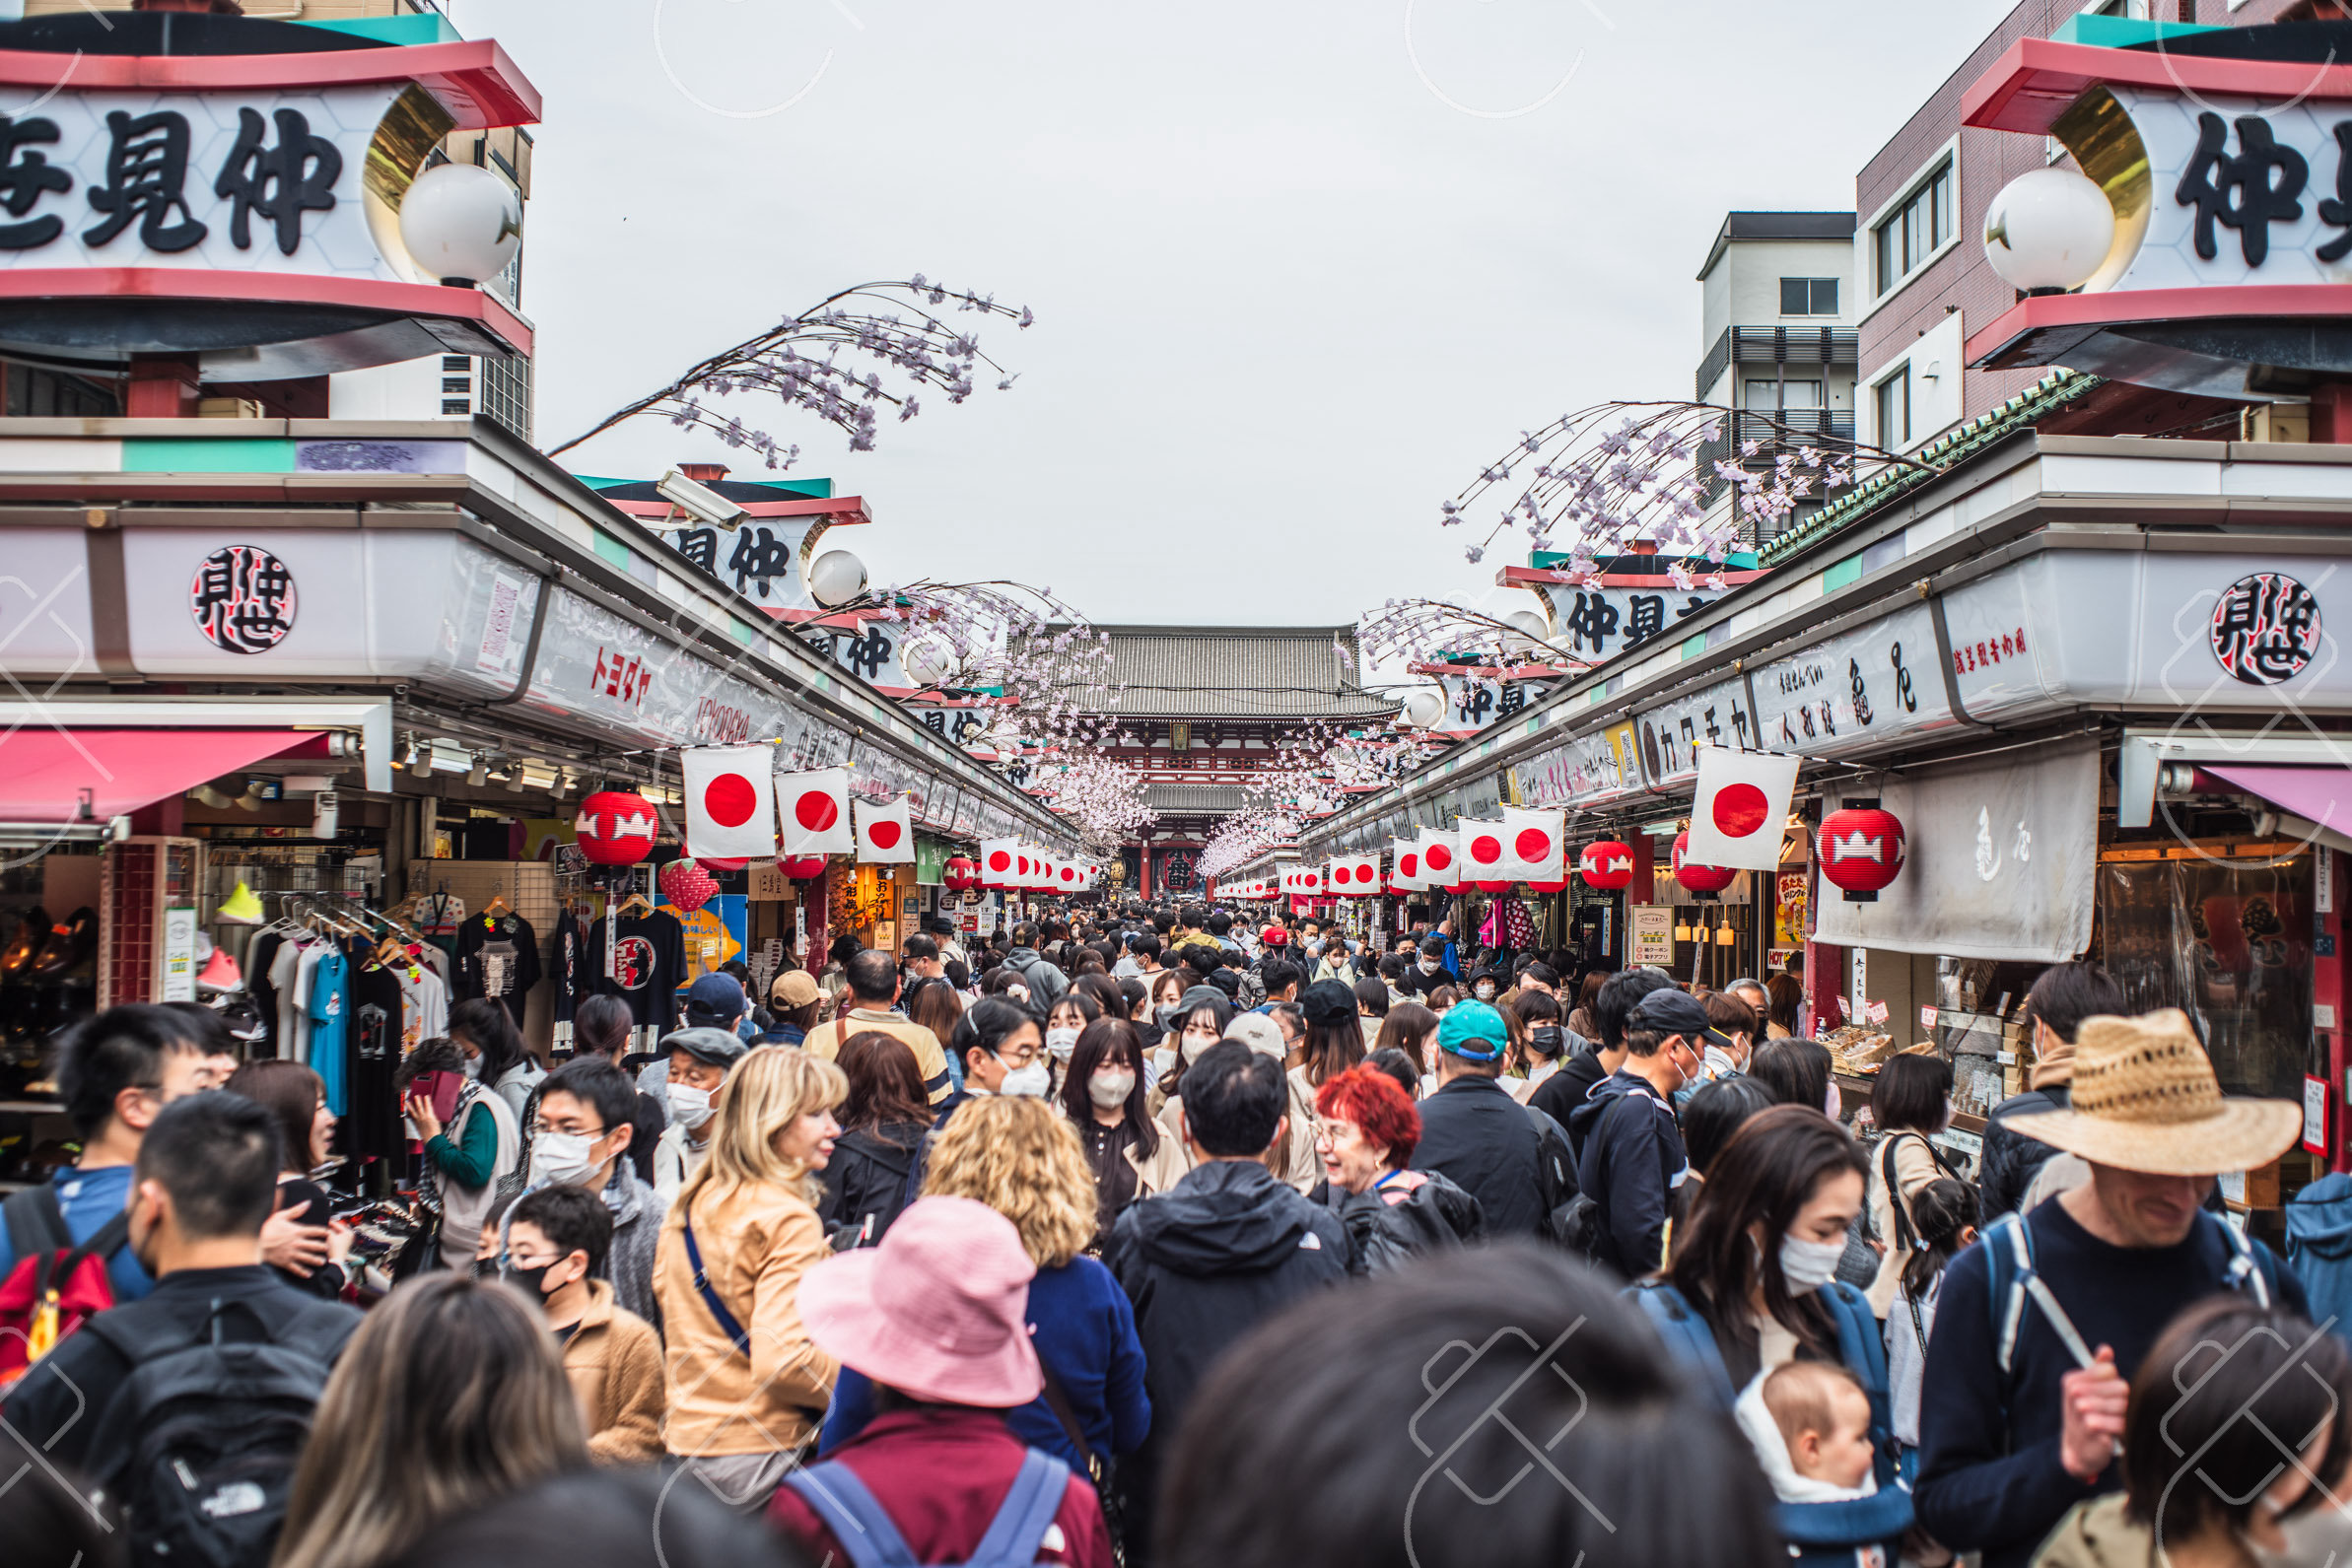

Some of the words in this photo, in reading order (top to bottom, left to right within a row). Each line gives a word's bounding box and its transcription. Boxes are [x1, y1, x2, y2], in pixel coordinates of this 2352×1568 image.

[2176, 110, 2352, 267] 仲
[1660, 698, 1747, 774] カワチヤ
[1768, 950, 1783, 966] HOT
